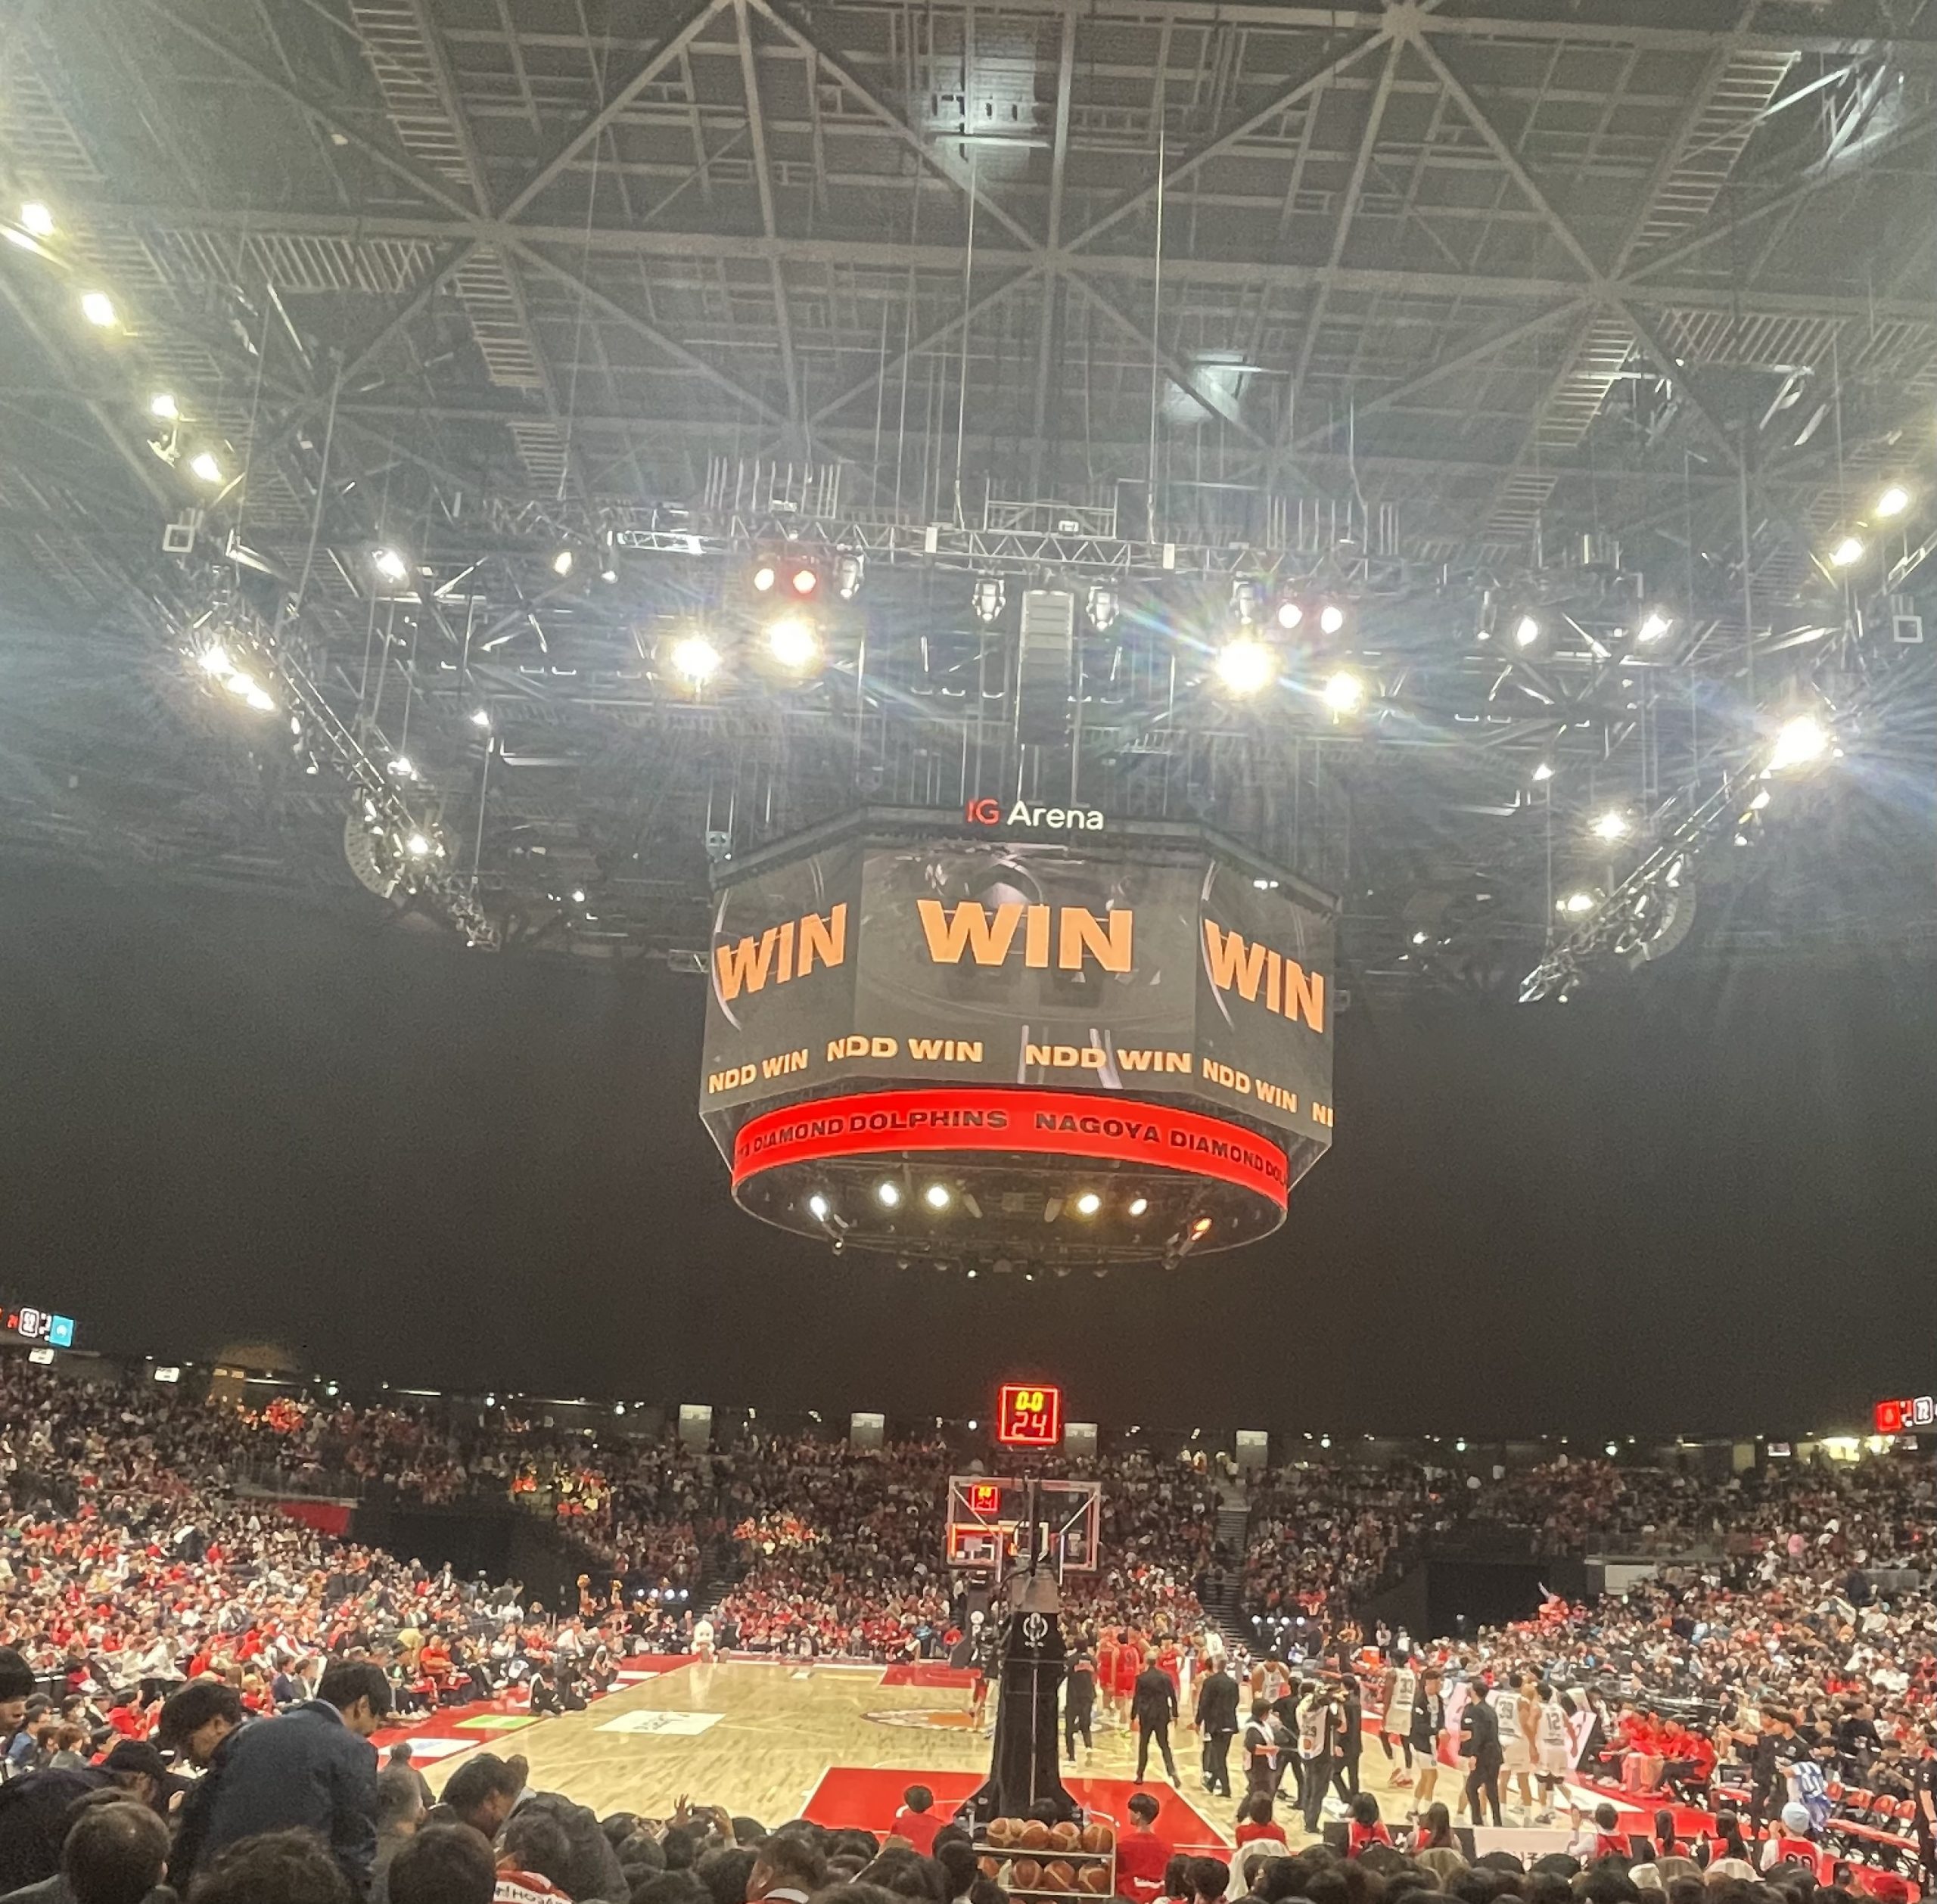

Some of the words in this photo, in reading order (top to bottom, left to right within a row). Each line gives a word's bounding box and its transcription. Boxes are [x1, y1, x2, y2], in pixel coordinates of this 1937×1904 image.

[967, 799, 1000, 825] IG
[1007, 800, 1105, 831] Arena
[717, 902, 847, 1002] WIN
[916, 899, 1133, 973] WIN
[1205, 918, 1324, 1033] WIN
[707, 1063, 757, 1094] NDD
[761, 1048, 809, 1079] WIN
[827, 1035, 899, 1062] NDD
[908, 1038, 983, 1063] WIN
[1025, 1044, 1107, 1068] NDD
[1117, 1048, 1192, 1073] WIN
[1202, 1058, 1251, 1095] NDD
[1255, 1079, 1298, 1114] WIN
[754, 1118, 844, 1153] DIAMOND
[849, 1110, 1007, 1133] DOLPHINS
[1035, 1112, 1161, 1144] NAGOYA
[1170, 1129, 1264, 1172] DIAMOND
[1011, 1411, 1048, 1437] 24
